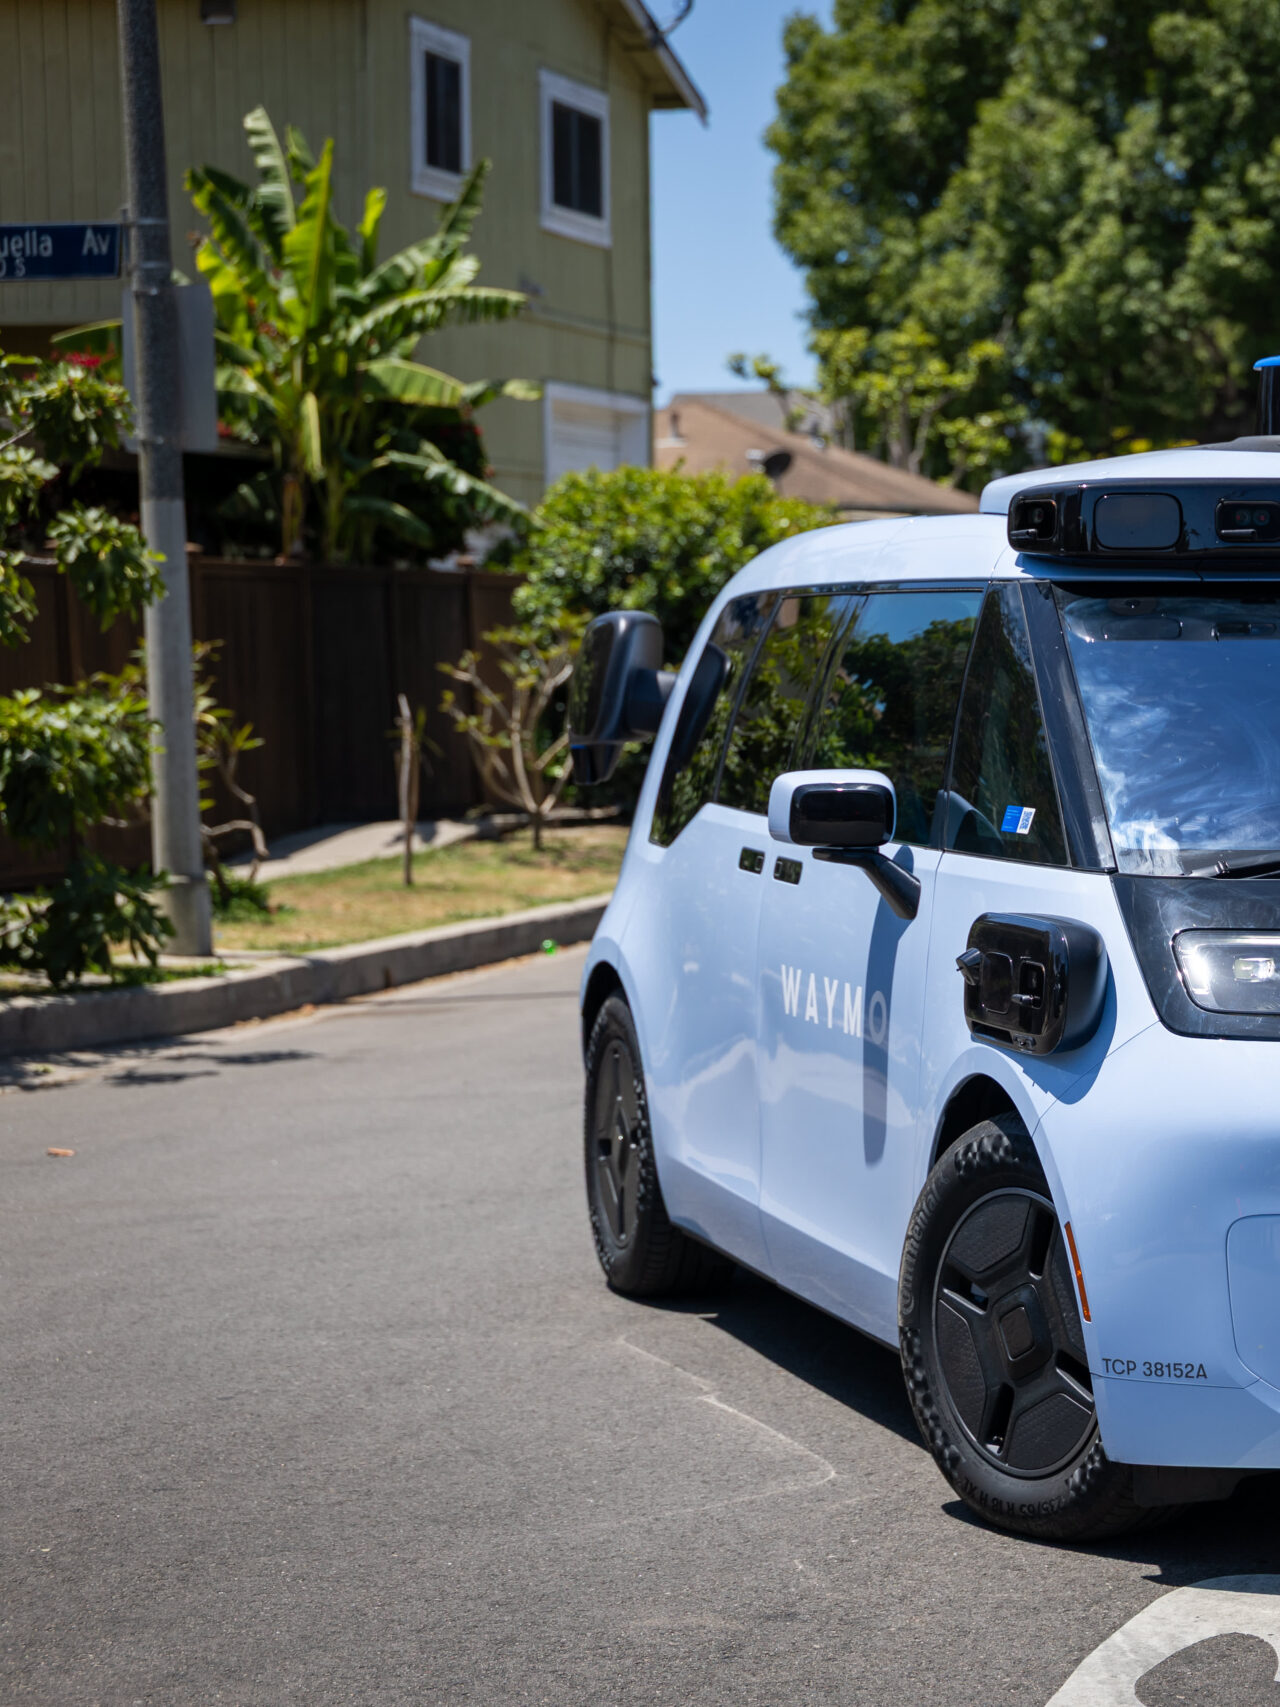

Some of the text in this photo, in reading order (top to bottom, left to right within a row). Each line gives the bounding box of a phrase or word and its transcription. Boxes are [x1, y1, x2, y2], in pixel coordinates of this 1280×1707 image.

[81, 226, 111, 256] Av
[781, 964, 887, 1045] WAYMO
[1102, 1358, 1208, 1379] TCP 38152A
